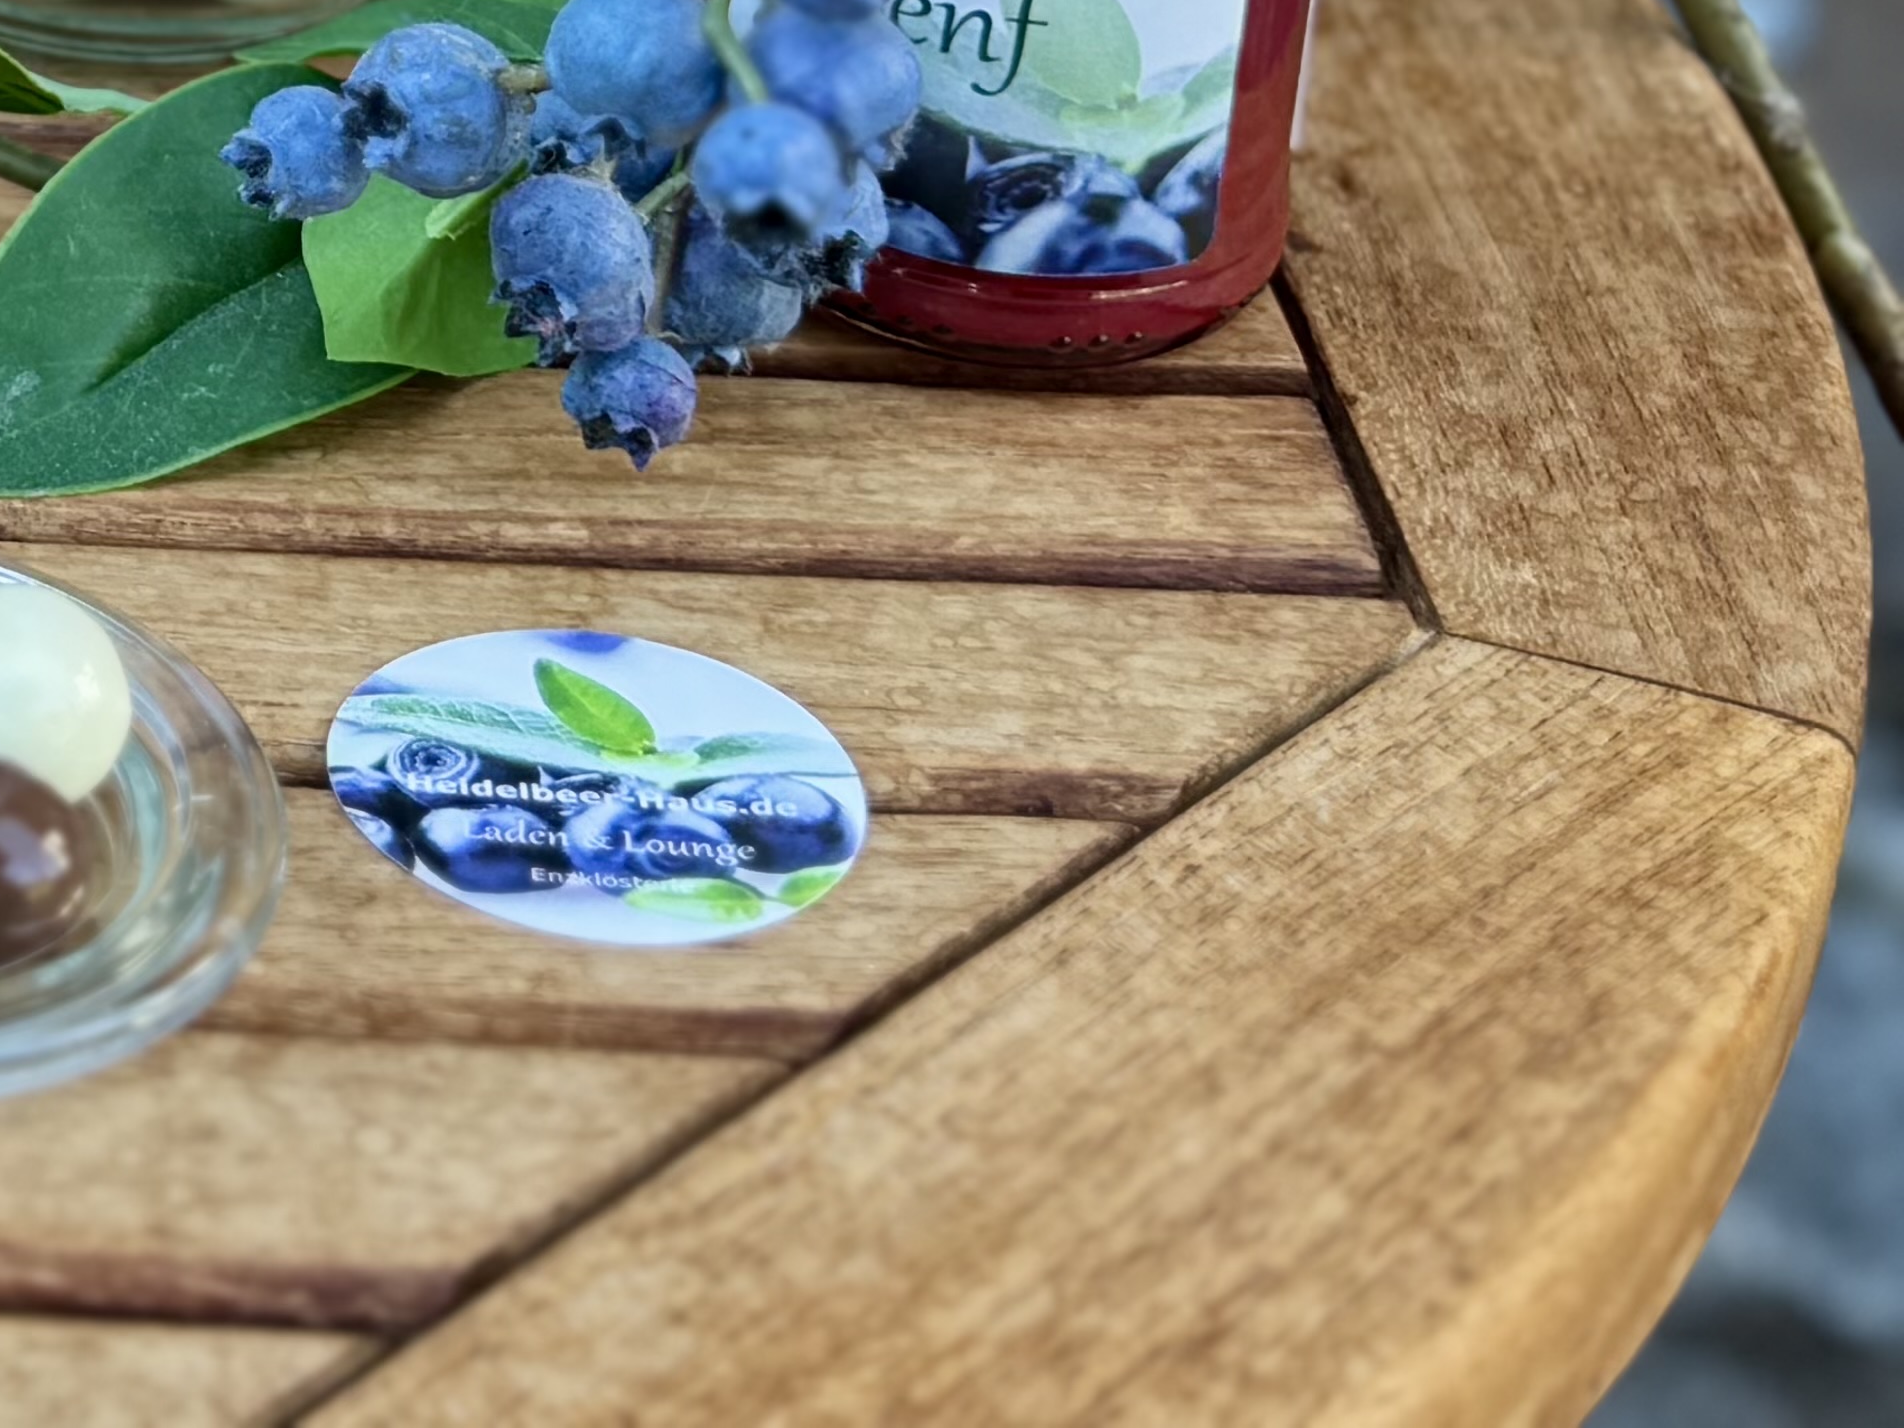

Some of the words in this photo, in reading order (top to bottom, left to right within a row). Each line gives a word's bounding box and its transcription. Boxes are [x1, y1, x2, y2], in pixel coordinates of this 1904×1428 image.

[406, 772, 799, 817] Heidelbeer-Haus.de
[464, 817, 569, 846] Laden
[623, 829, 757, 867] Lounge
